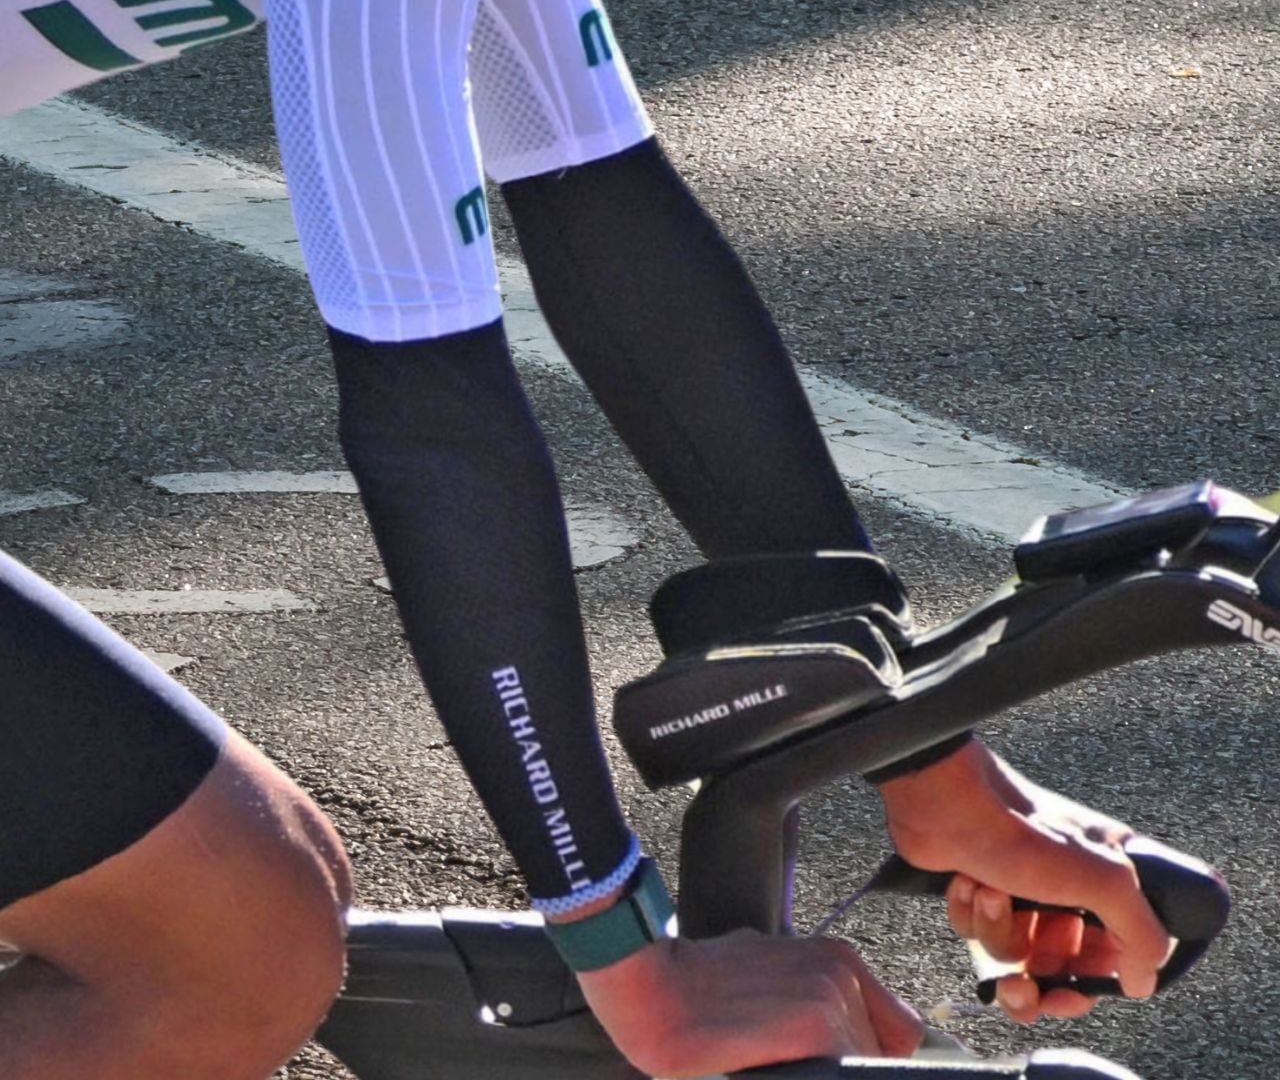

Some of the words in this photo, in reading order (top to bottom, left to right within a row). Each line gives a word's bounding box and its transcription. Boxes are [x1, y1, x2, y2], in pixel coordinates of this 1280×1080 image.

[492, 665, 559, 805] RICHARD
[649, 703, 730, 740] RICHARD
[733, 684, 788, 712] MILLE
